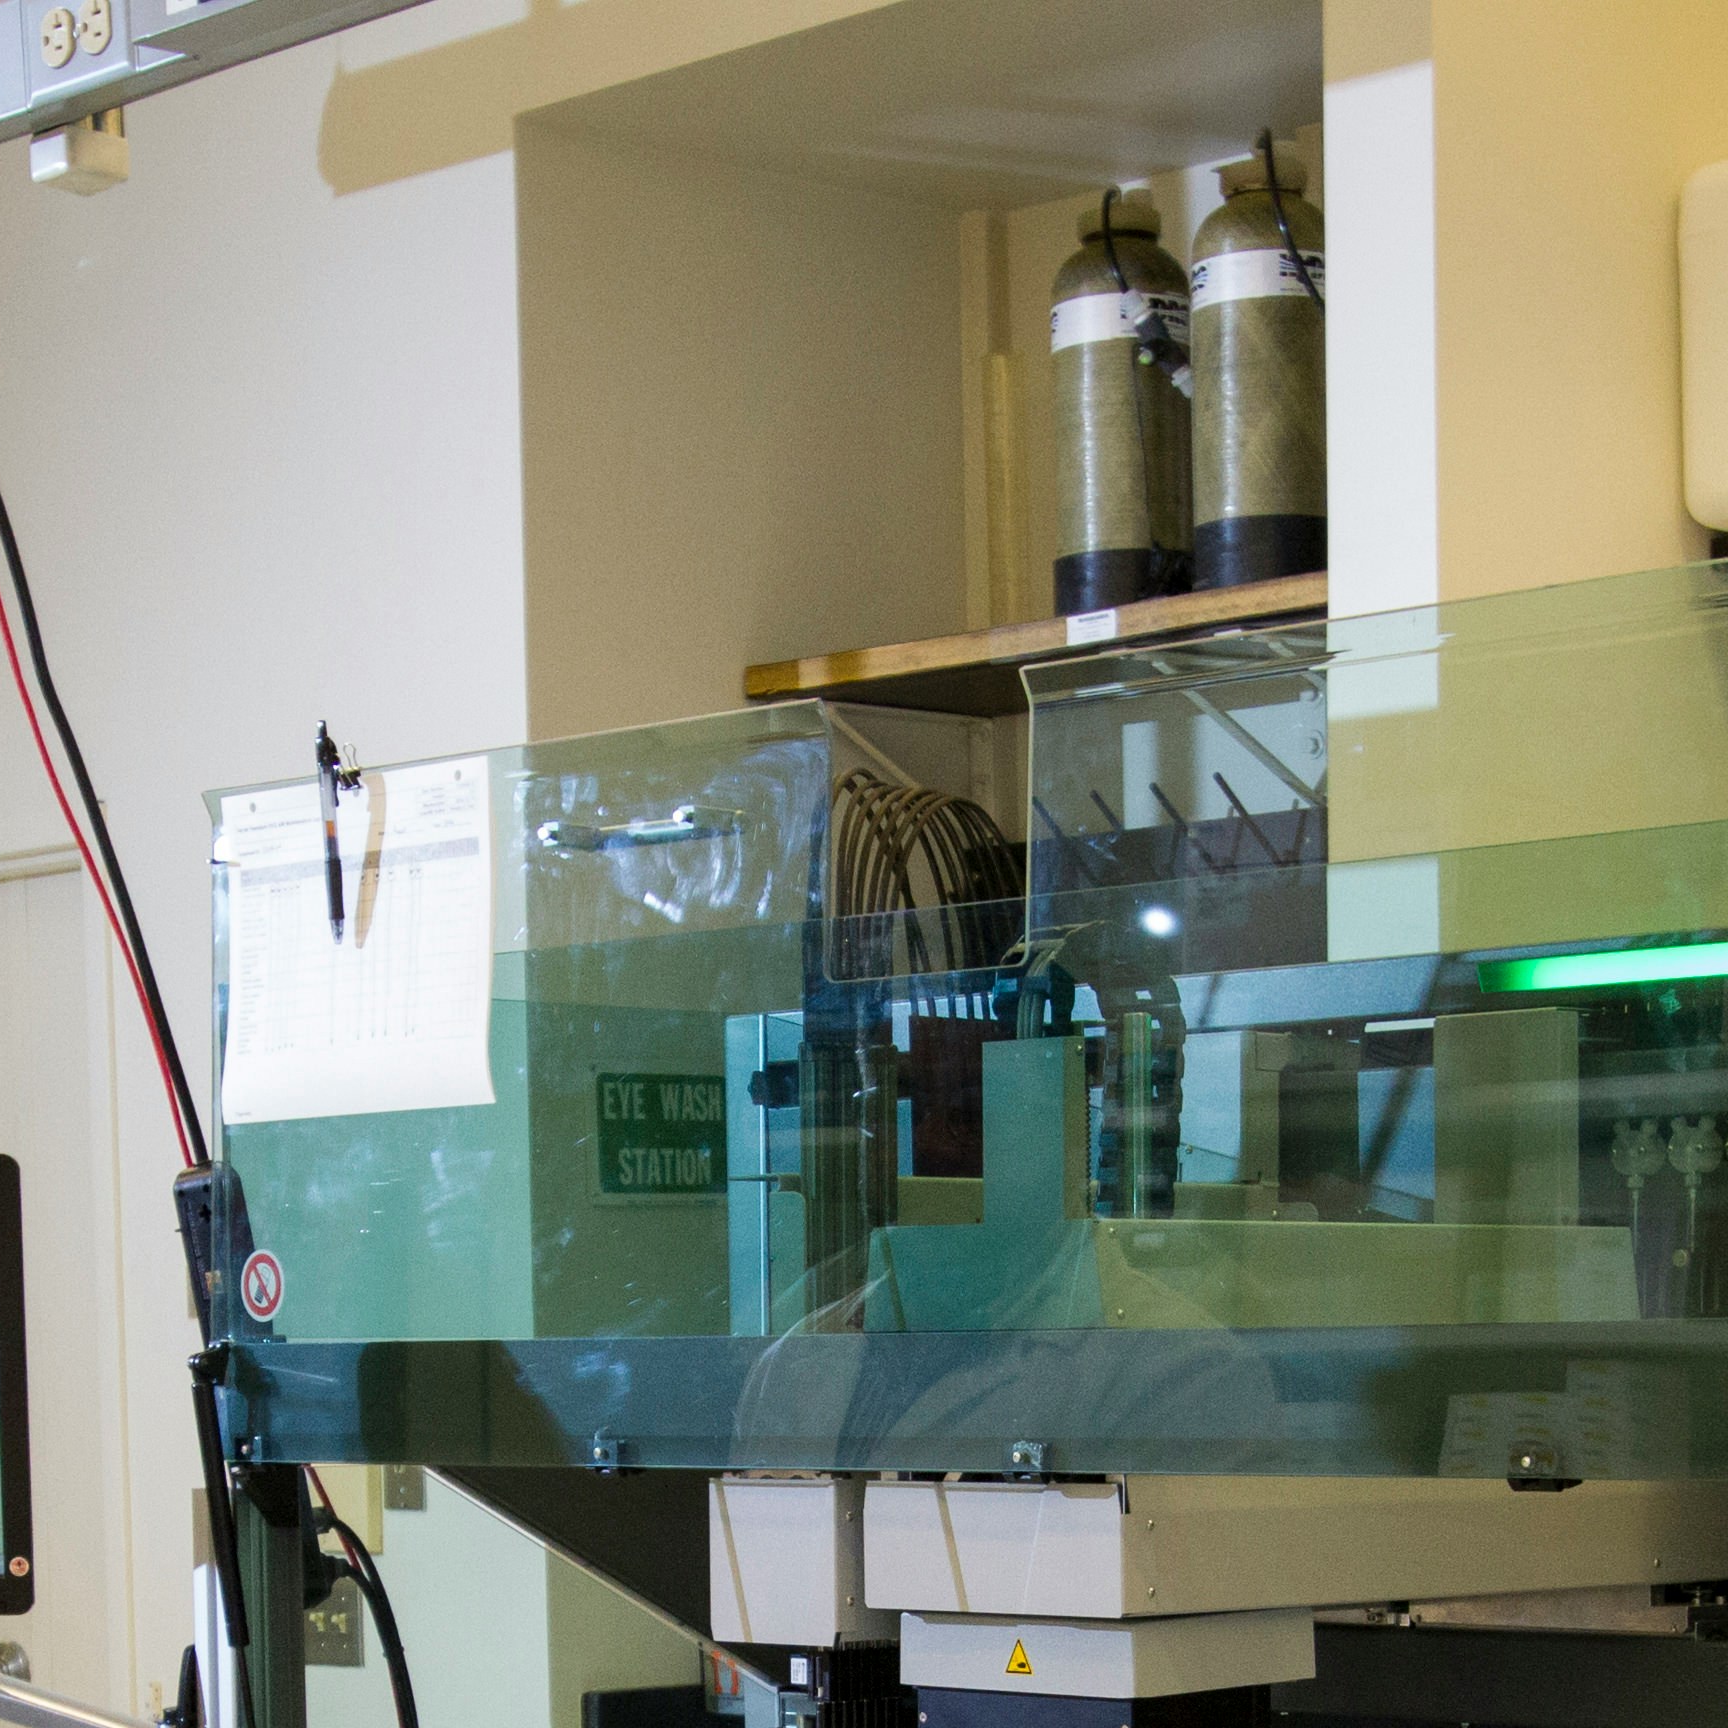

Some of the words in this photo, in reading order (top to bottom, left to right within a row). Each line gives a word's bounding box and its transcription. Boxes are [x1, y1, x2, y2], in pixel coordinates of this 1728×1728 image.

[603, 1081, 646, 1120] EYE
[659, 1082, 721, 1122] WASH
[618, 1147, 712, 1185] STATION
